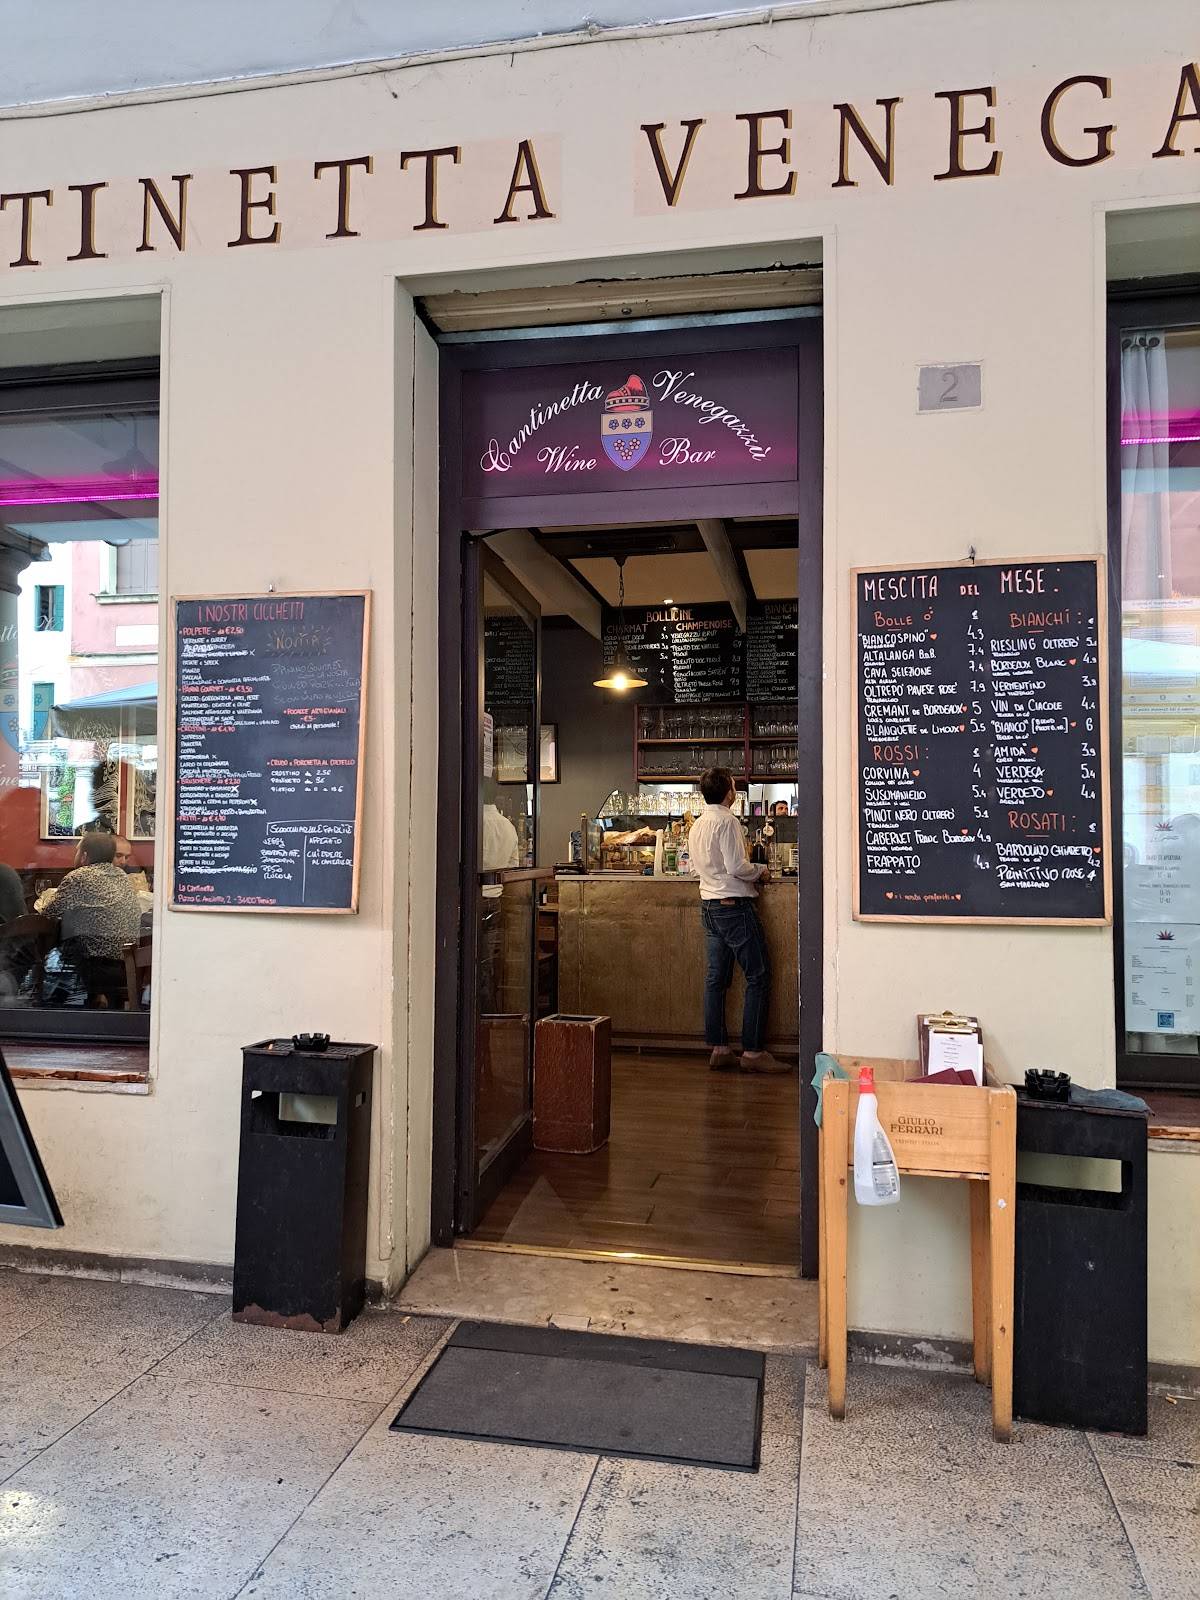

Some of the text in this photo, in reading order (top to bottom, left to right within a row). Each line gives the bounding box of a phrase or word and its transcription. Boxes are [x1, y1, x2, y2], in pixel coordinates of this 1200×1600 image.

[940, 372, 958, 402] 2
[480, 380, 605, 472] Cantinetta
[536, 437, 716, 473] Wine Bar
[864, 575, 938, 602] MESCITA
[960, 584, 980, 596] DEL
[205, 604, 248, 622] NOSTRI
[253, 602, 304, 621] CICCHETTI
[646, 608, 694, 623] BOLLICINE
[874, 610, 913, 628] BOLLE
[606, 619, 733, 634] CHARMAT CHAMPENOISE
[967, 624, 984, 640] 4.3
[863, 644, 985, 662] ALTALANGA 7.4
[990, 638, 1036, 652] RIESLING
[864, 660, 984, 678] CAVA SELEZIONE 7.4
[990, 660, 1031, 672] BORDEAUX
[906, 684, 936, 696] PAVESE
[970, 680, 986, 692] 7.9
[992, 680, 1046, 692] VERMENTINO
[864, 704, 910, 718] CREMANT
[922, 702, 964, 716] BORDEAUX
[972, 700, 982, 715] 5
[990, 696, 1096, 712] VIN DA CIACOLE 4.4
[866, 724, 918, 737] BLANQUETTE
[932, 724, 960, 735] LIMOUX
[970, 718, 986, 732] 5.5
[1085, 717, 1094, 732] 6
[863, 763, 982, 780] CORVINA 4
[996, 763, 1096, 779] VERDECA 5.4
[972, 784, 987, 798] 5.4
[996, 784, 1096, 800] VERDEJO 4.4
[864, 808, 892, 822] PINOT
[894, 809, 918, 822] NERO
[974, 806, 990, 819] 5.1
[865, 830, 912, 846] CABERNET
[914, 830, 938, 844] FRANC
[976, 828, 992, 843] 4.9
[866, 854, 921, 868] FRAPPATO
[996, 864, 1059, 881] PRIMITIVO
[1086, 870, 1097, 882] 4
[898, 1116, 936, 1126] GIULIO
[890, 1124, 944, 1136] FERRARI
